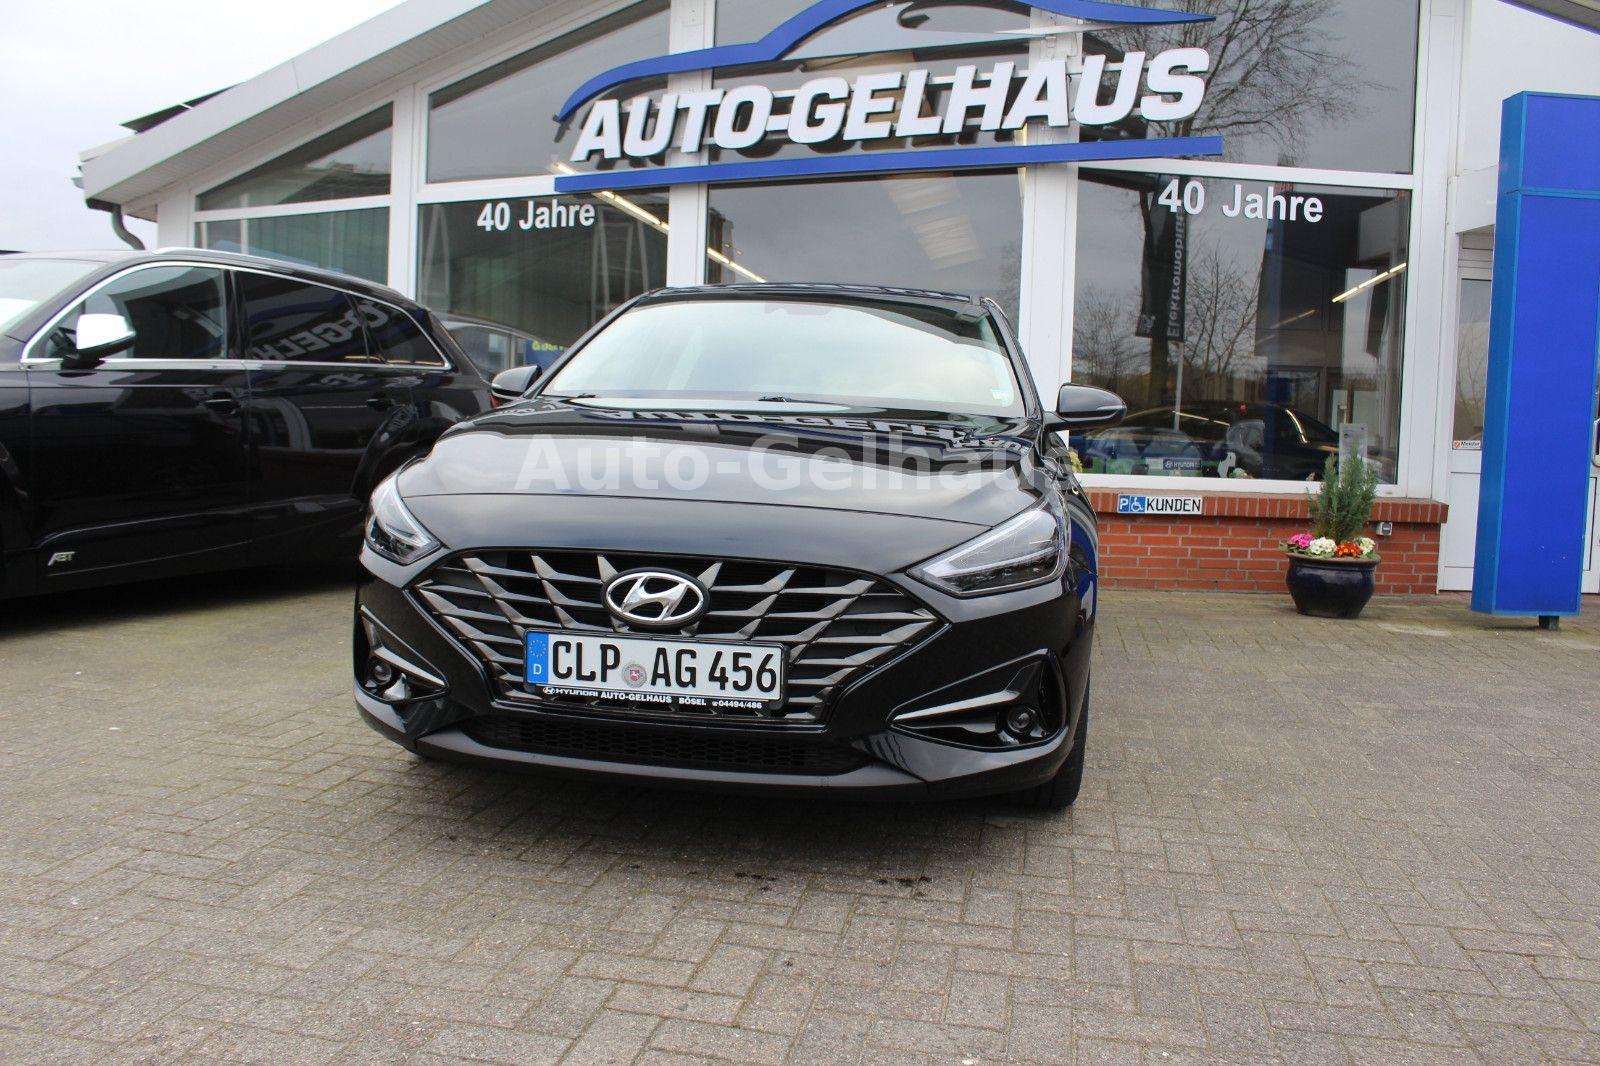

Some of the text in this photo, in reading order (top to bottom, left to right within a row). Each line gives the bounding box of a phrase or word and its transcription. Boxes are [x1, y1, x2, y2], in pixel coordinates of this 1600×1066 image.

[570, 47, 1212, 163] AUTO-GELHAUS
[476, 198, 596, 232] 40 Jahre
[1158, 178, 1324, 223] 40 Jahre
[1146, 497, 1201, 512] KUNDEN
[533, 663, 542, 675] D
[552, 640, 621, 683] CLP
[650, 646, 697, 688] AG
[708, 650, 777, 693] 456
[556, 688, 599, 697] HYUNDAI
[601, 691, 672, 703] AUTO-GELHAUS
[678, 695, 707, 706] BÖSEL
